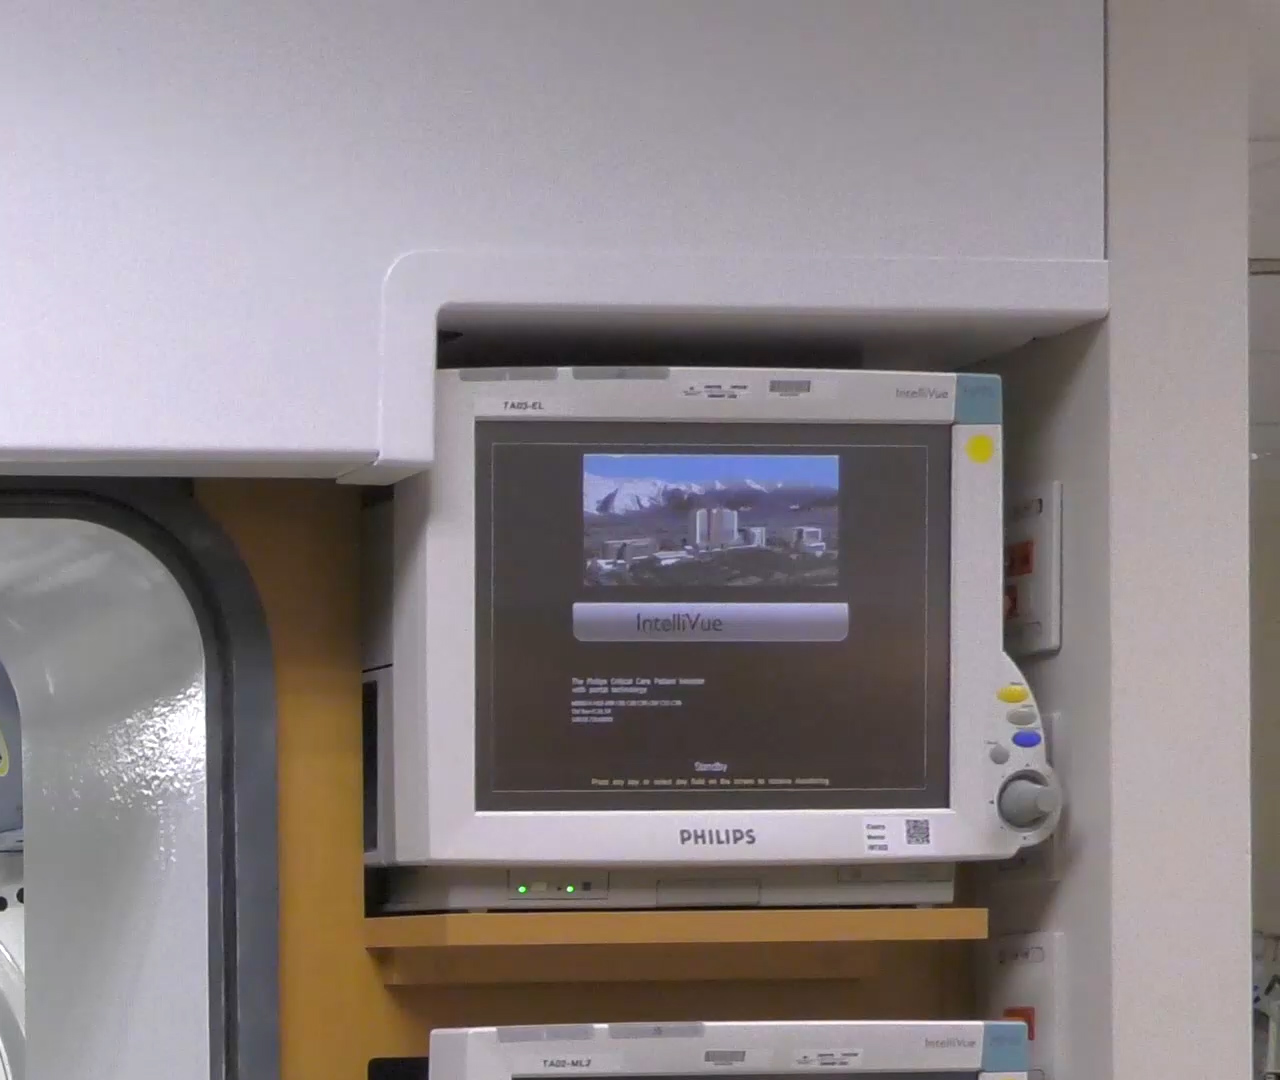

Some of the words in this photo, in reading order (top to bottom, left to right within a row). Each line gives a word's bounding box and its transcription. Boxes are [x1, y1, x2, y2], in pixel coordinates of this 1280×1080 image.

[895, 387, 949, 399] IntelliVue
[636, 612, 723, 632] IntelliVue
[679, 828, 757, 845] PHILIPS
